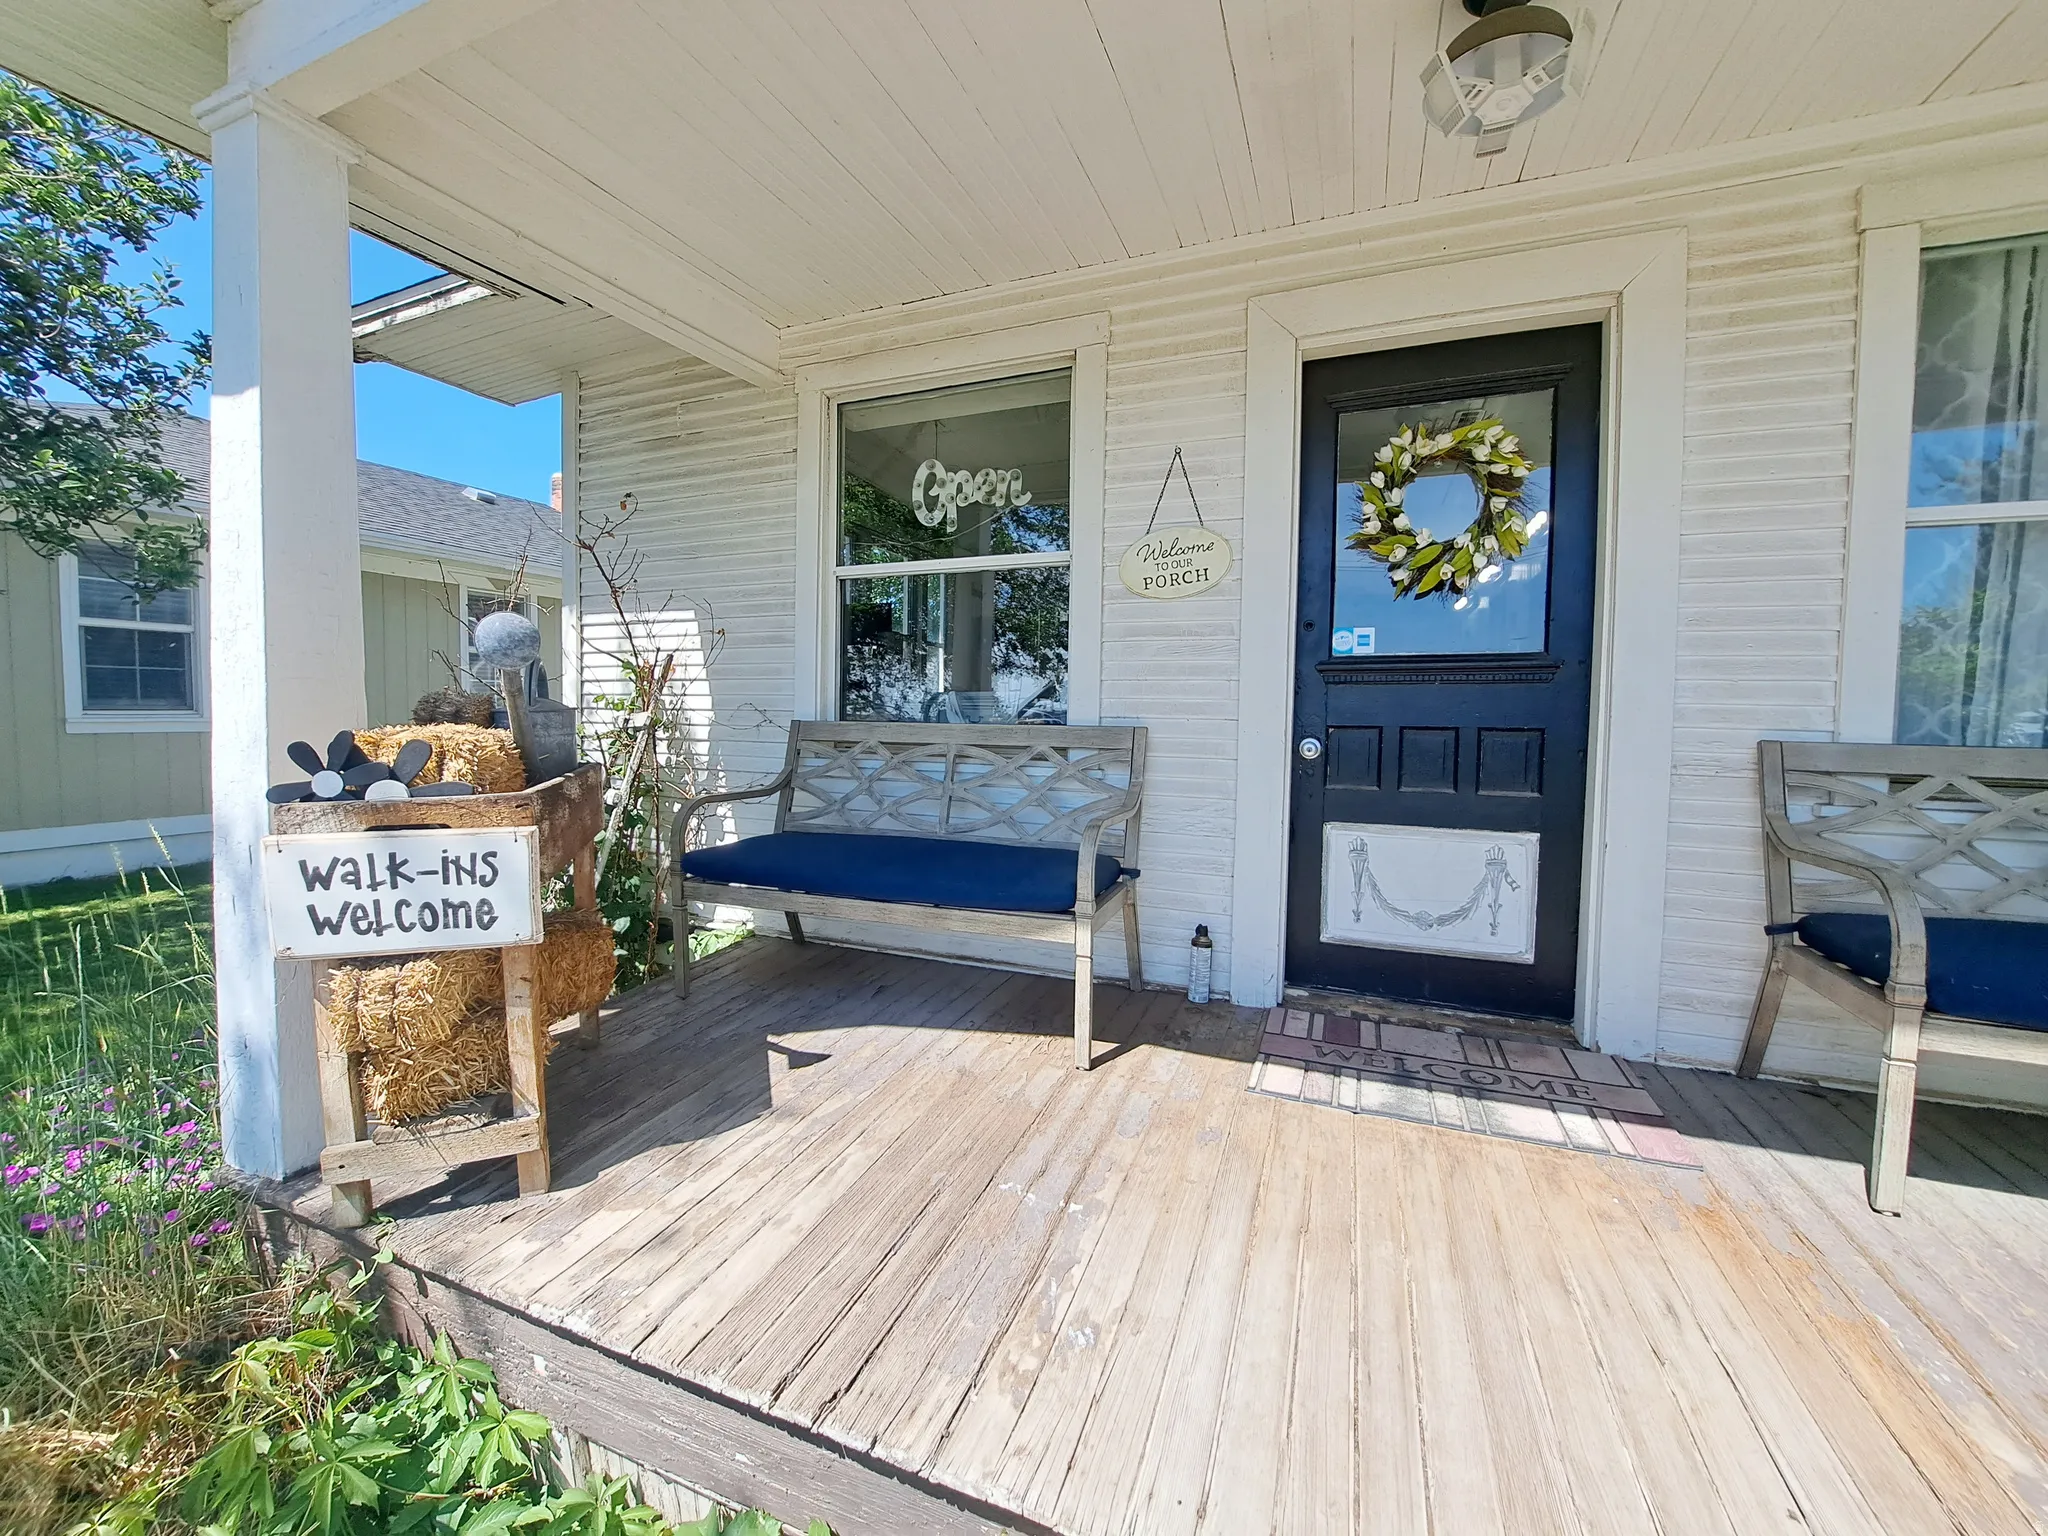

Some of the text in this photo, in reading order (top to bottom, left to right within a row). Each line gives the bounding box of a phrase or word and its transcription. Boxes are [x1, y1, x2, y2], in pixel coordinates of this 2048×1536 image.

[912, 458, 1032, 534] Open
[1136, 537, 1215, 563] Welcome
[1155, 558, 1193, 572] TO OUR
[1143, 568, 1209, 590] PORCH
[1311, 1044, 1598, 1101] WELCOME
